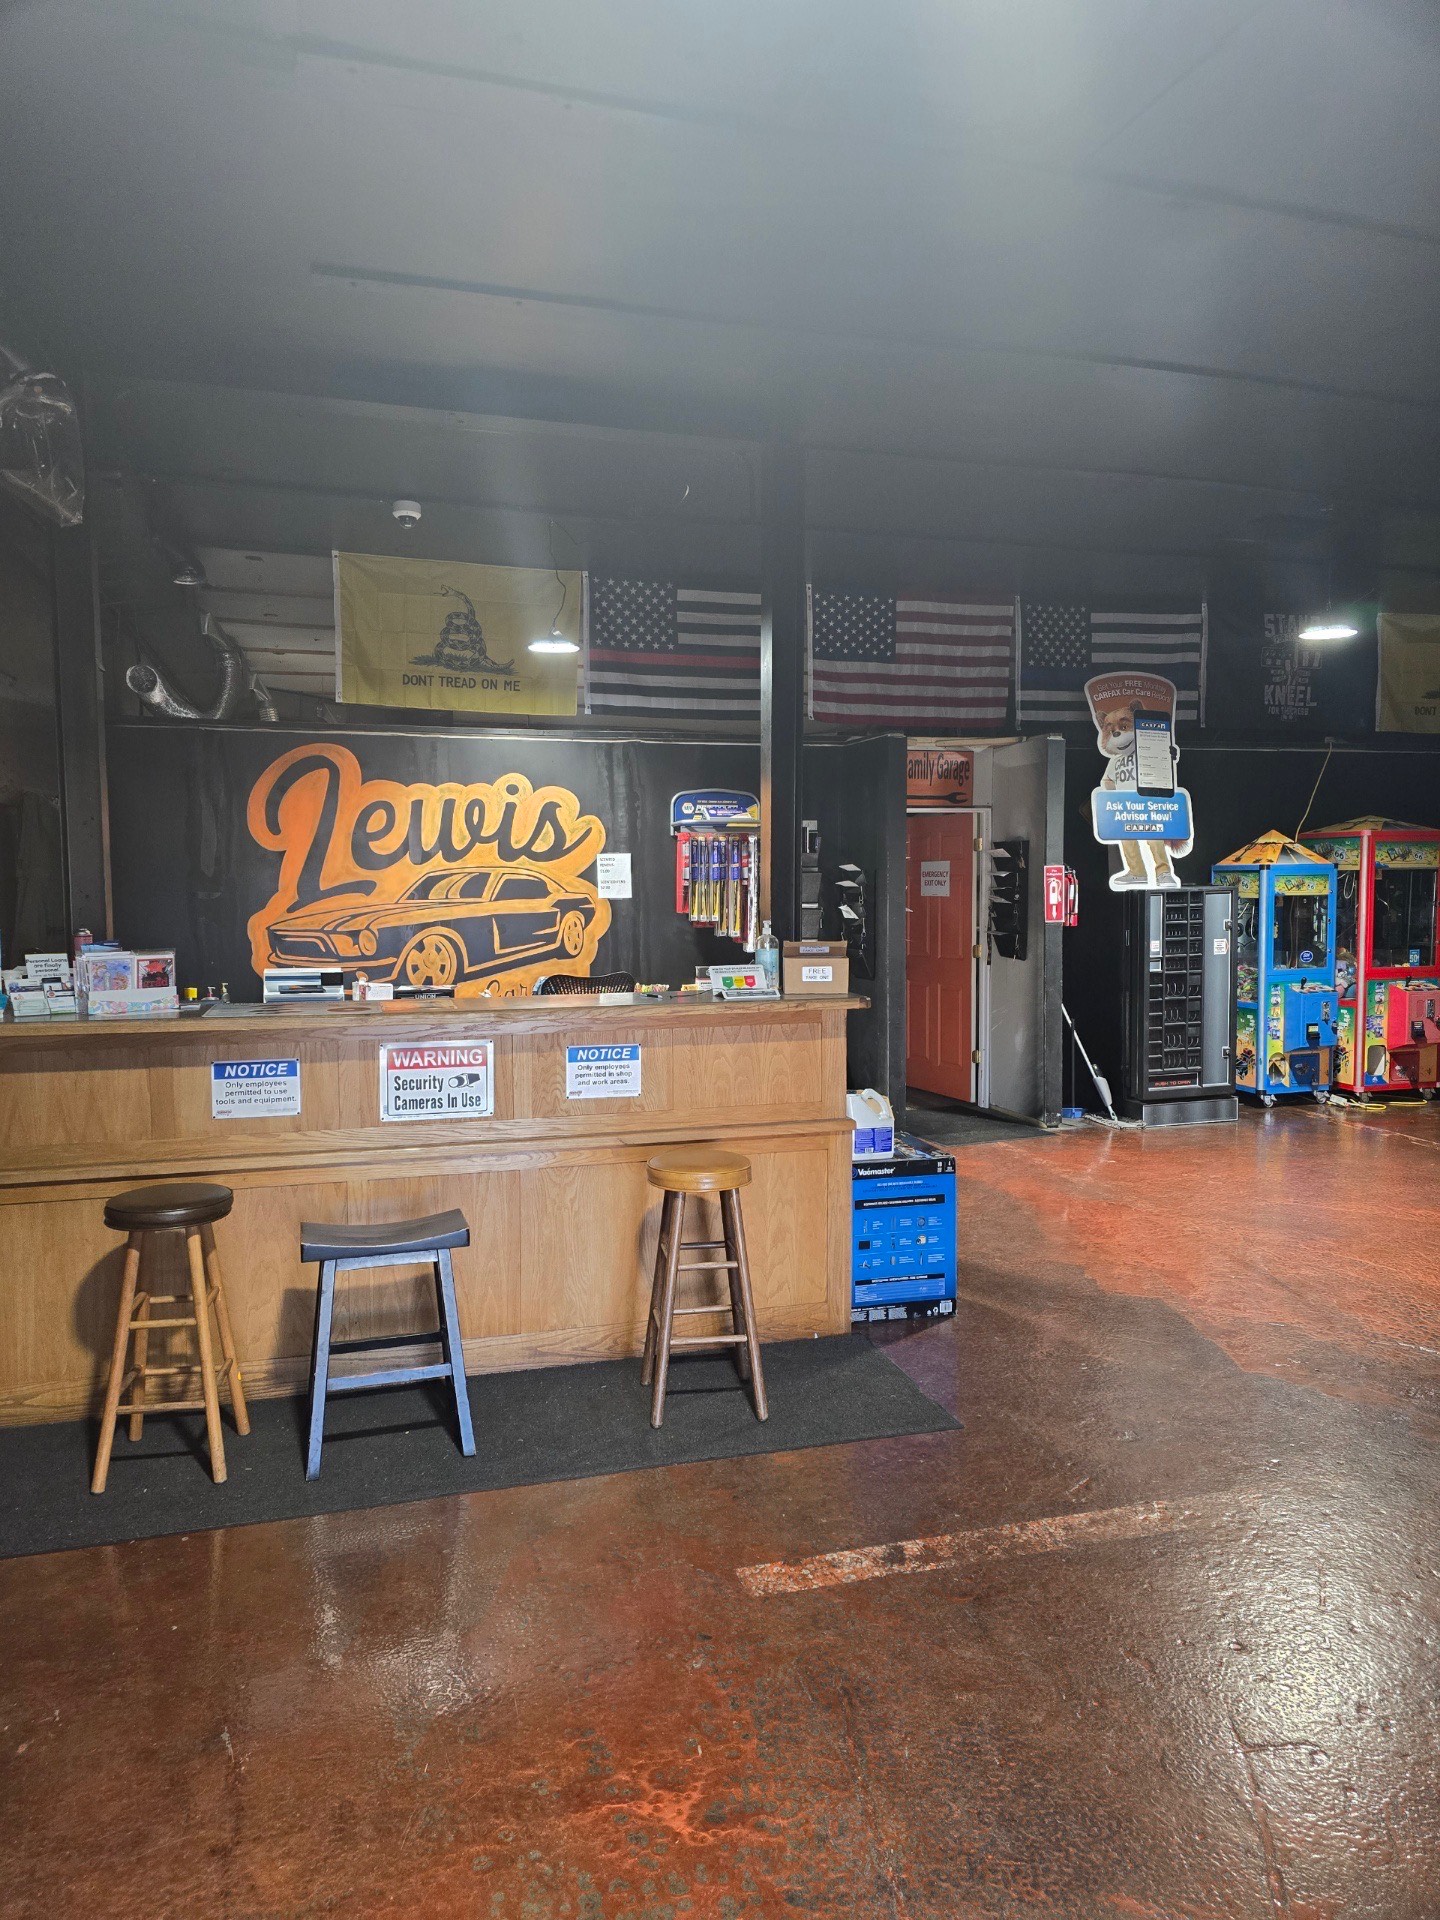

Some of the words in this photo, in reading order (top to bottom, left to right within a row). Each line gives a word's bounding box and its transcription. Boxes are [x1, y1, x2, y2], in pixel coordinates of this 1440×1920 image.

[402, 674, 434, 687] DONT
[438, 675, 477, 689] TREAD
[481, 676, 499, 690] ON
[504, 678, 521, 692] ME
[1125, 680, 1142, 688] FREE
[1093, 689, 1121, 702] CARFAX
[1135, 689, 1151, 697] Care
[1264, 684, 1317, 707] KNEEL
[1414, 706, 1437, 716] DONT
[1114, 755, 1134, 771] CAR
[907, 752, 935, 786] amily
[936, 753, 970, 787] Garage
[1114, 768, 1136, 785] FOX
[1106, 801, 1123, 811] Ask
[1125, 801, 1145, 811] Your
[1147, 801, 1179, 811] Service
[1114, 812, 1148, 821] Advisor
[264, 754, 593, 913] Lewis
[1125, 824, 1164, 832] CARFAX
[1334, 848, 1345, 860] 66
[1414, 853, 1423, 861] 66
[392, 1049, 483, 1067] WARNING
[577, 1048, 632, 1060] NOTICE
[224, 1062, 289, 1078] NOTICE
[577, 1064, 593, 1072] Only
[594, 1063, 630, 1071] employees
[575, 1071, 607, 1080] permitted
[225, 1081, 244, 1089] Only
[245, 1080, 287, 1089] employees
[394, 1074, 444, 1093] Security
[225, 1089, 262, 1098] permitted
[253, 1096, 297, 1105] equipment.
[394, 1094, 443, 1111] Cameras
[447, 1093, 458, 1108] In
[461, 1092, 481, 1107] Use
